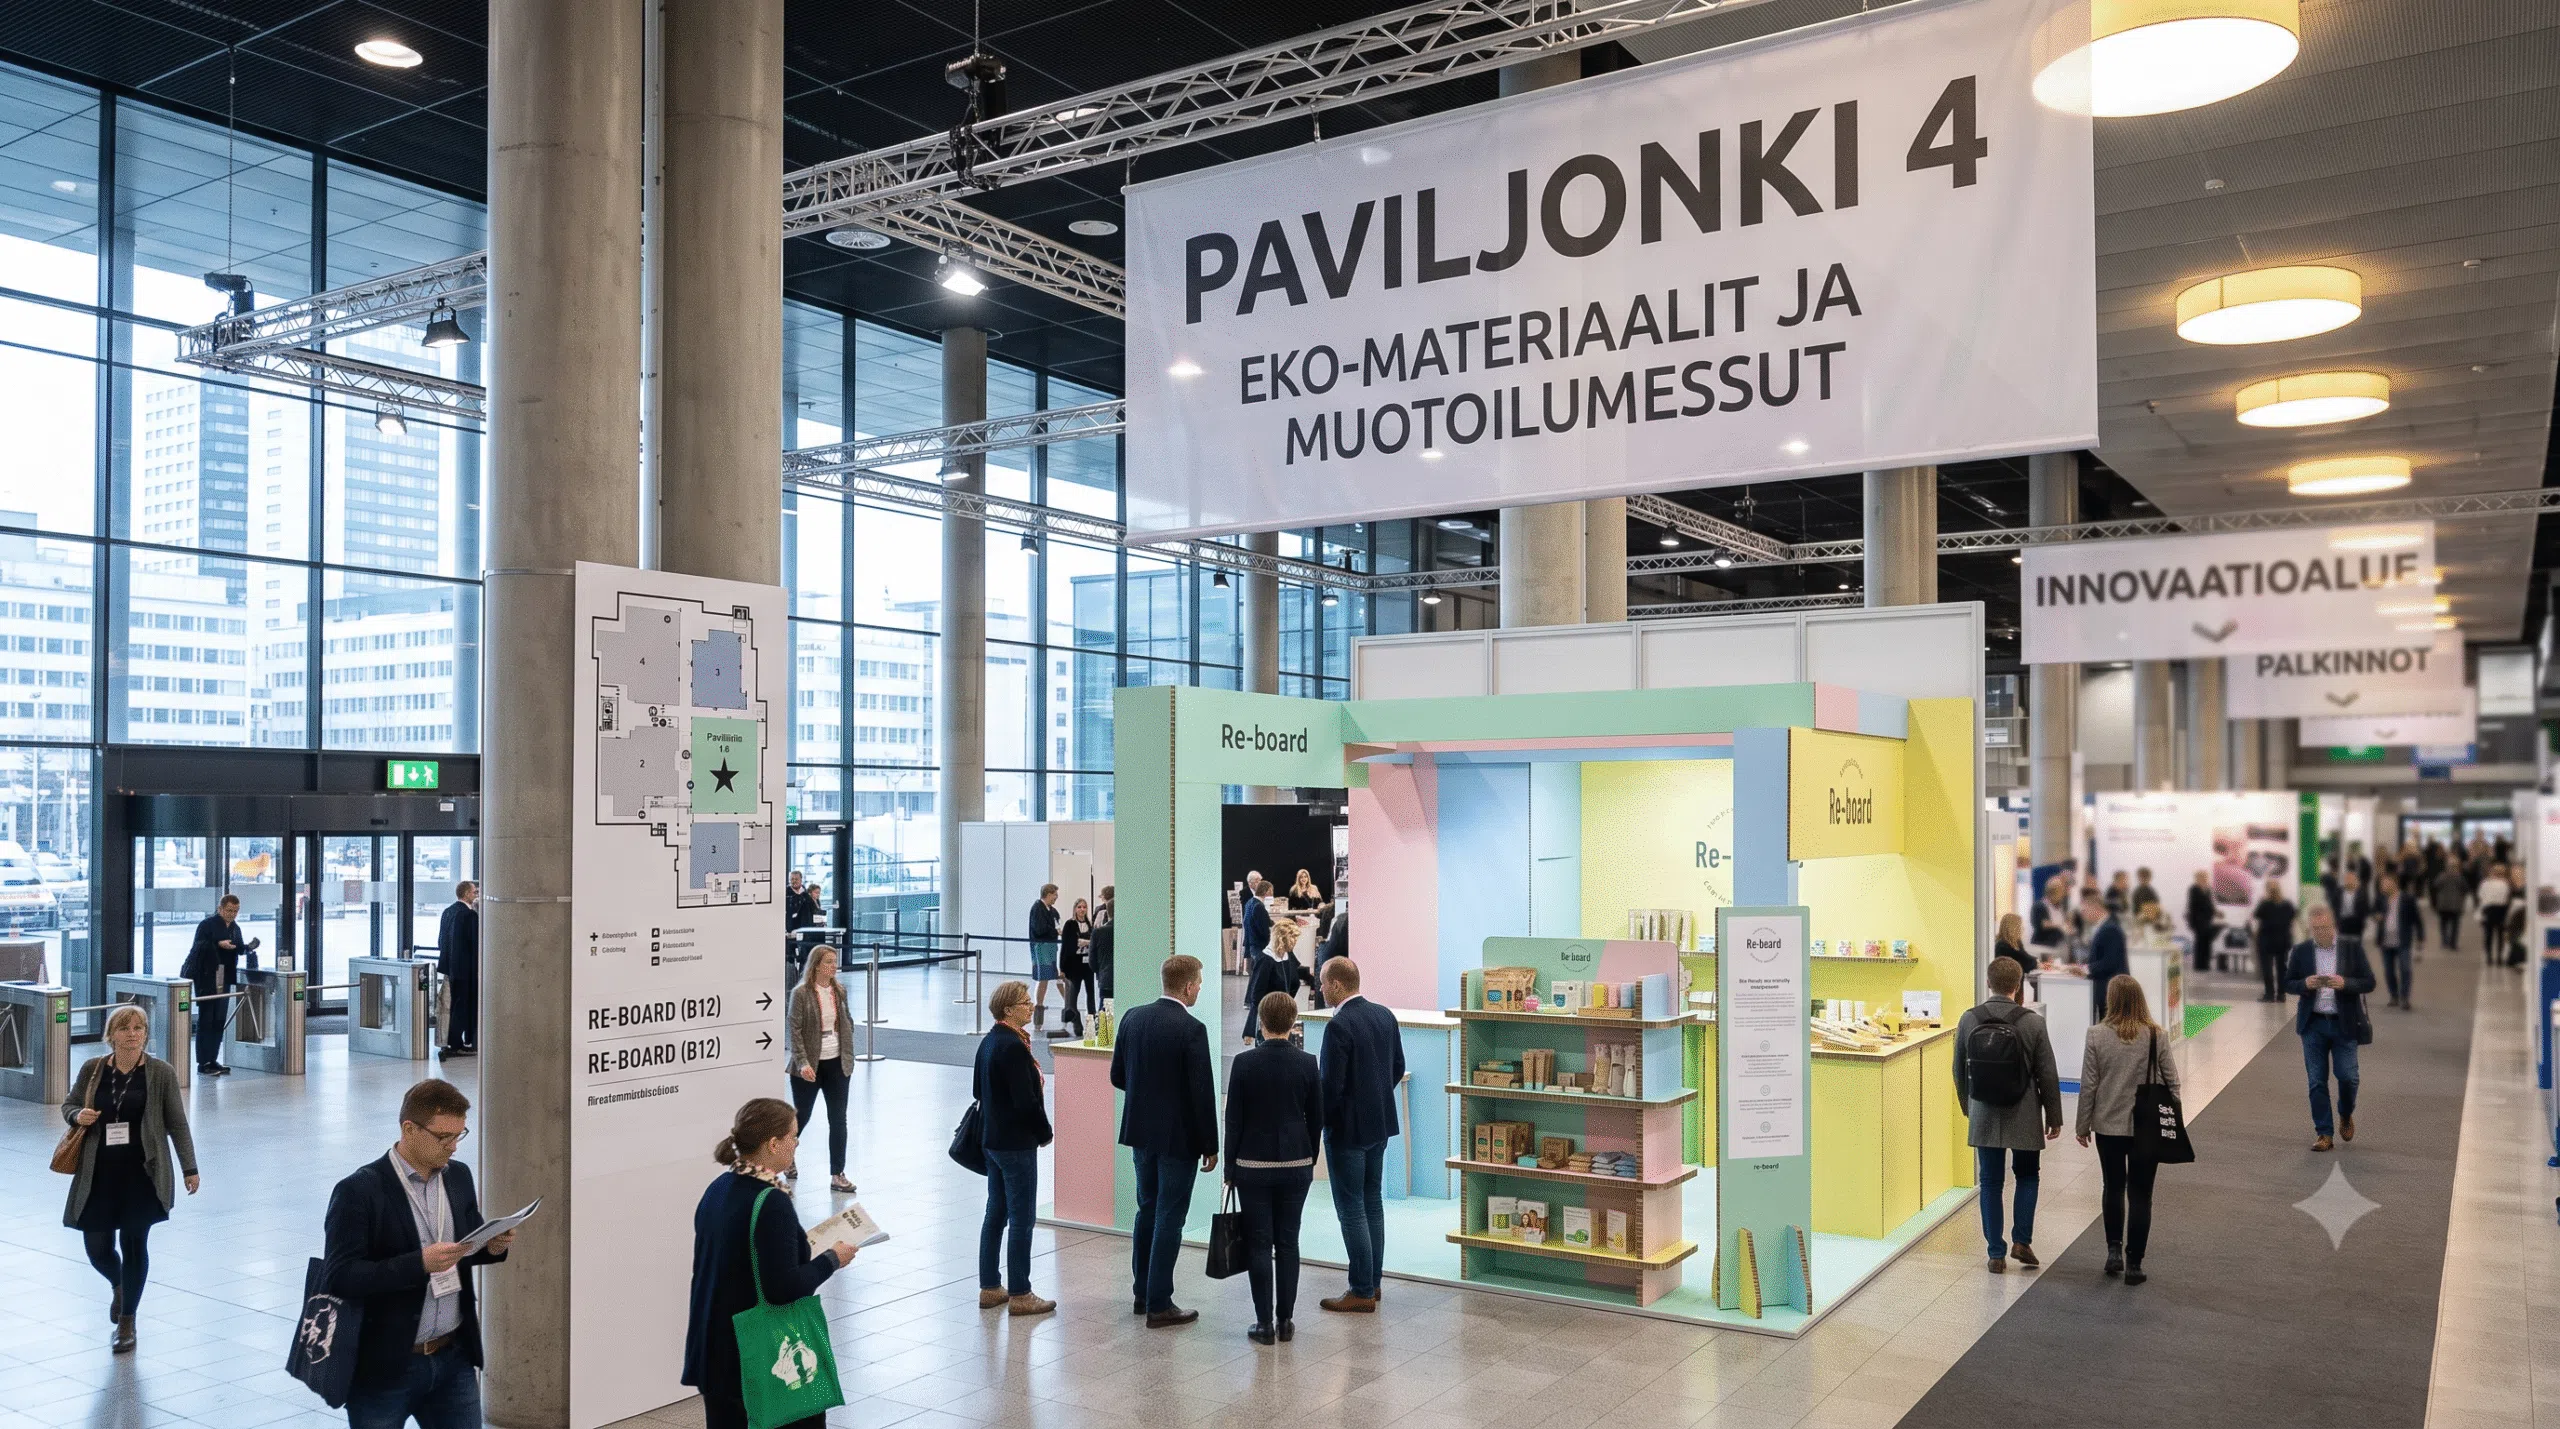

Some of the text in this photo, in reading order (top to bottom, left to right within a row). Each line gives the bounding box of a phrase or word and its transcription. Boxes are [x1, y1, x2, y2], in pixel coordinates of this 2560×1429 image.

[1184, 76, 1988, 324] PAVILJONKI 4
[1240, 262, 1863, 406] EKO-MATERIAALIT JA
[1285, 342, 1847, 466] MUOTOILUMESSUT
[639, 656, 646, 666] 4
[2256, 646, 2432, 677] PALKINNOT
[1222, 723, 1308, 754] Re-board
[639, 758, 646, 768] 2
[1829, 787, 1872, 825] Re-board
[588, 995, 722, 1030] RE-BOARD (B12)
[588, 1036, 722, 1074] RE-BOARD (B12)
